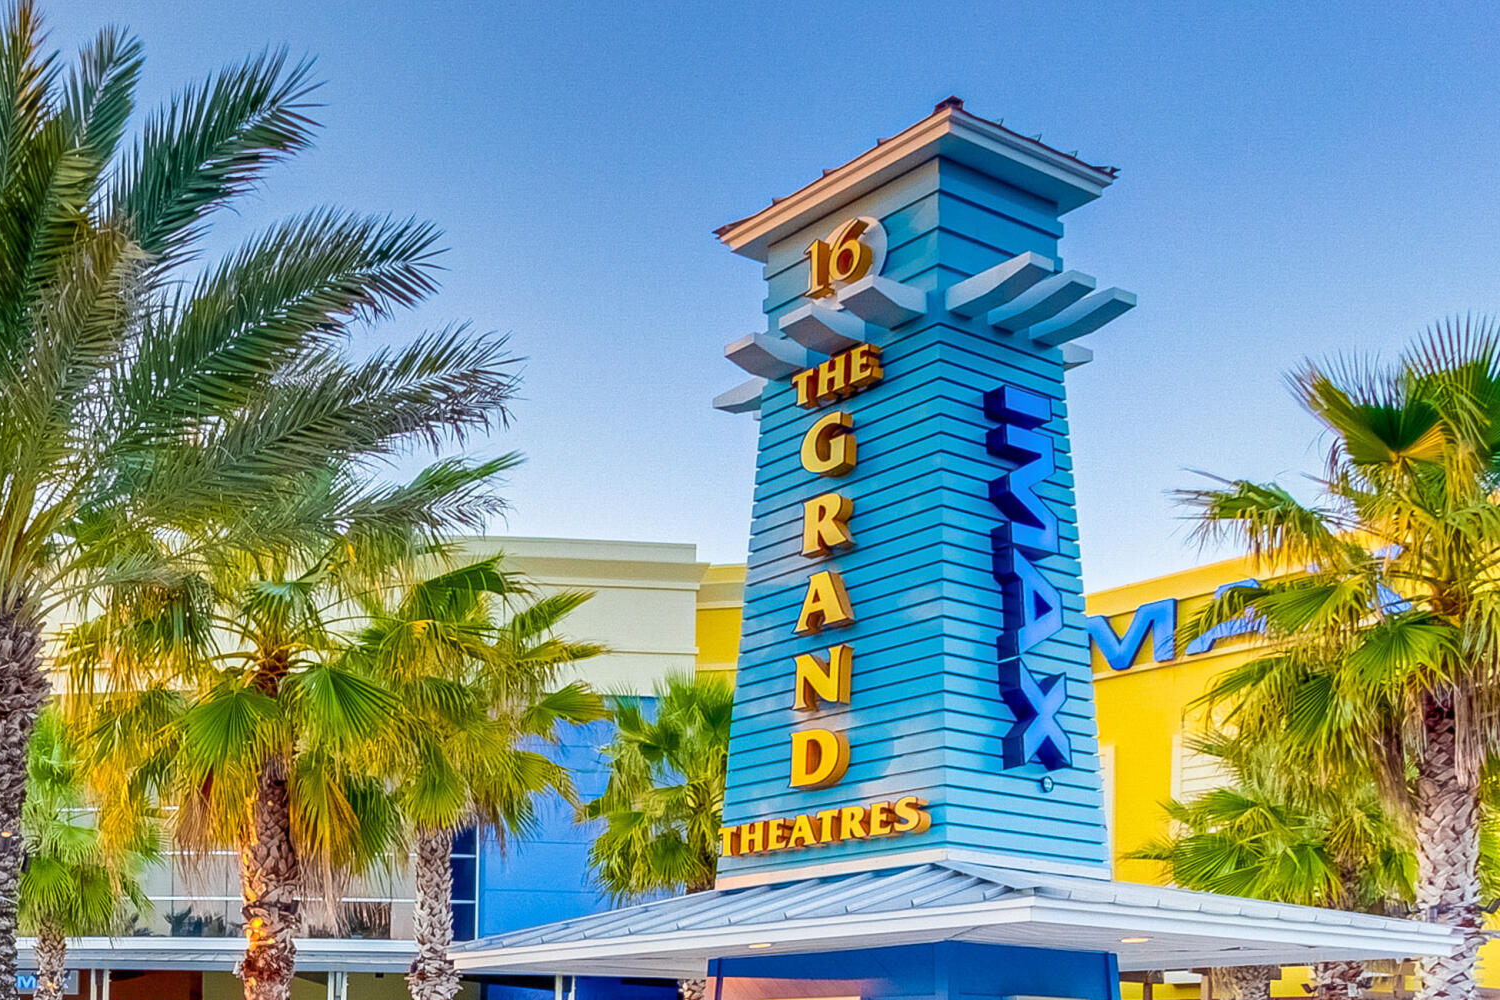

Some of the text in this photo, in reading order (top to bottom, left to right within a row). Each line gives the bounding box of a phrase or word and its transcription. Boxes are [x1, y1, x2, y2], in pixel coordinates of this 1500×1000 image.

[803, 217, 873, 299] 16
[792, 343, 883, 409] THE
[788, 410, 858, 791] GRAND
[983, 385, 1073, 772] IMAX
[718, 796, 932, 858] THEATRES
